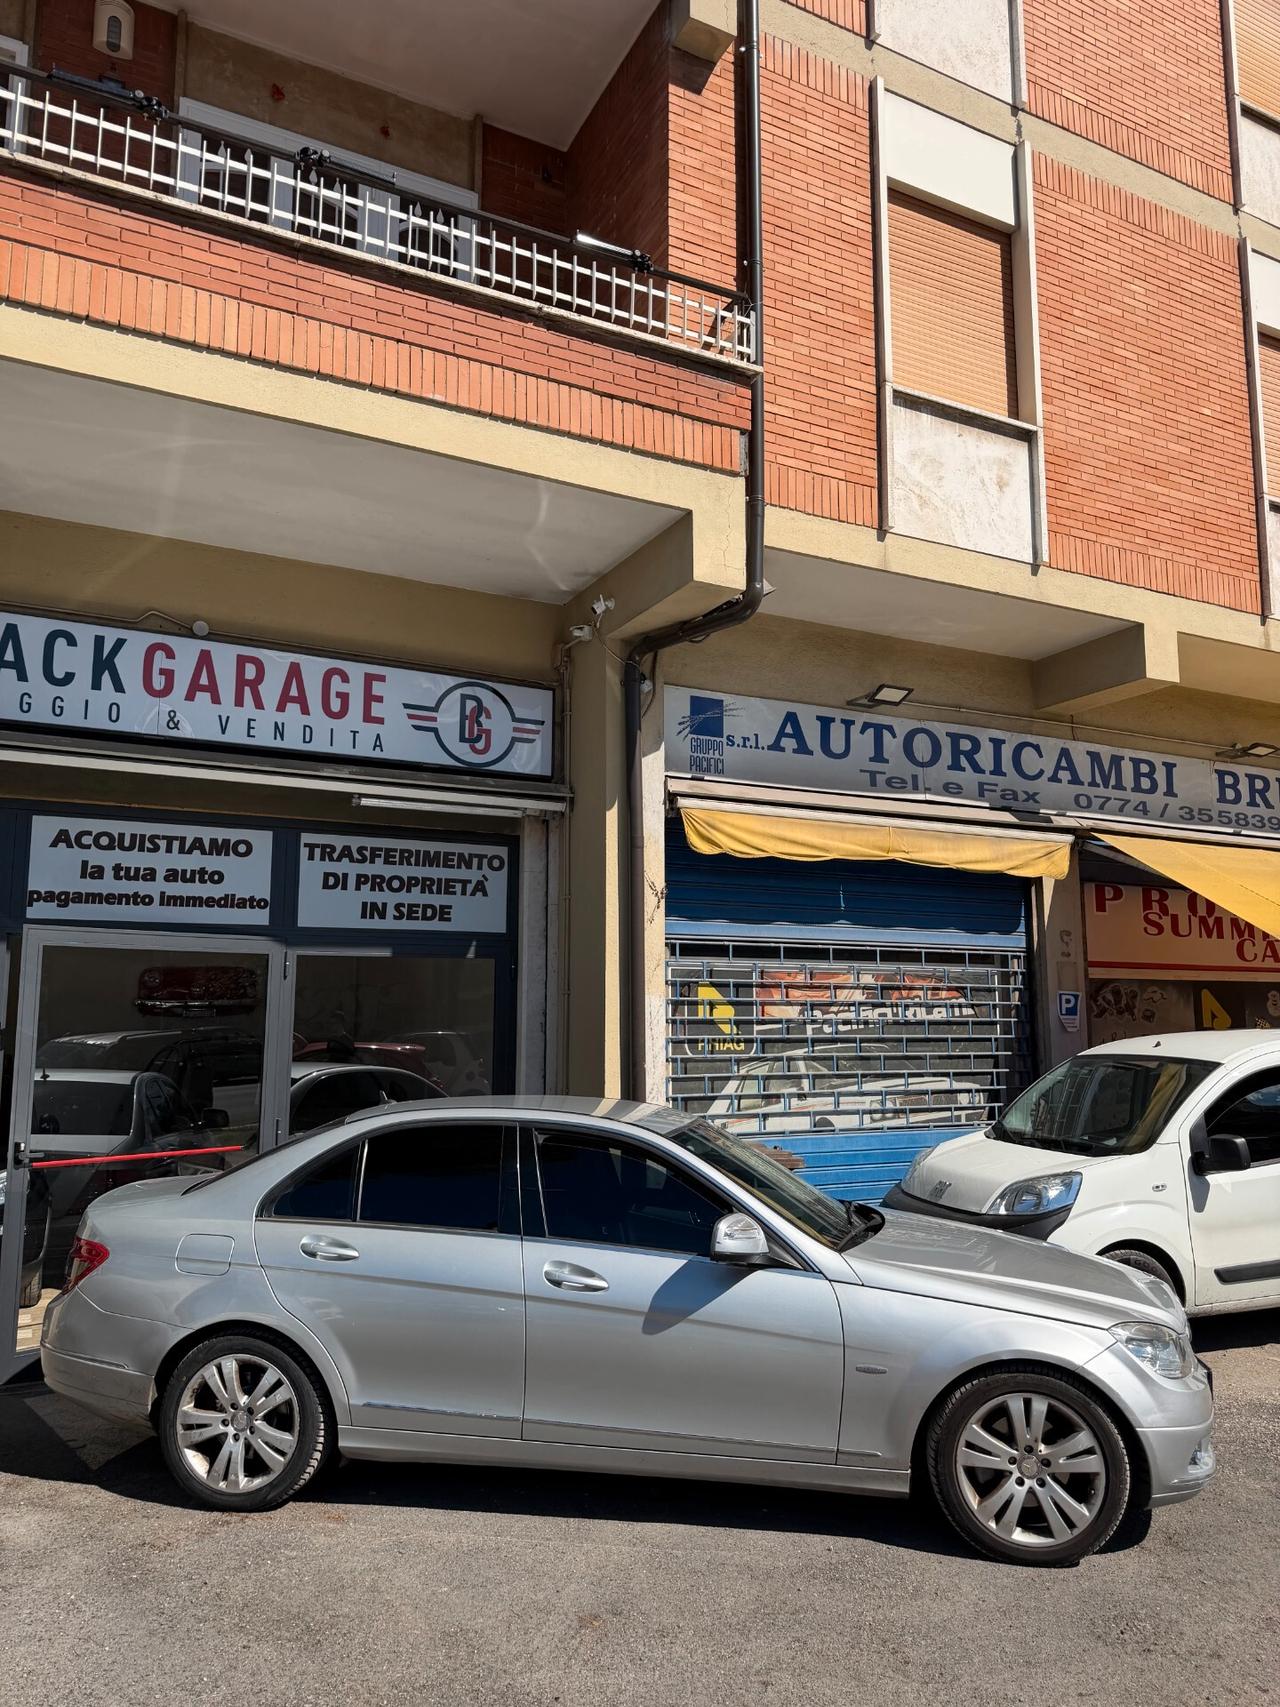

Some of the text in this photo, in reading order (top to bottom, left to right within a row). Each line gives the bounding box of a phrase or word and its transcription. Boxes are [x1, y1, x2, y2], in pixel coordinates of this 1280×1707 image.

[166, 709, 181, 731] &
[218, 714, 384, 752] VENDITA
[690, 737, 724, 756] GRUPPO
[689, 754, 725, 775] PACIFICI
[767, 710, 1179, 798] AUTORICAMBI
[1214, 768, 1280, 810] BR
[859, 768, 933, 792] Tel.
[942, 781, 964, 795] e
[977, 781, 1041, 804] Fax
[1074, 793, 1150, 816] 0774
[49, 828, 253, 858] ACQUISTIAMO
[303, 841, 506, 873] TRASFERIMENTO
[80, 860, 225, 886] la tua auto
[321, 871, 489, 898] DI PROPRIETÀ
[27, 889, 269, 910] pagamento immediato
[360, 901, 453, 923] IN SEDE
[1061, 994, 1076, 1015] P
